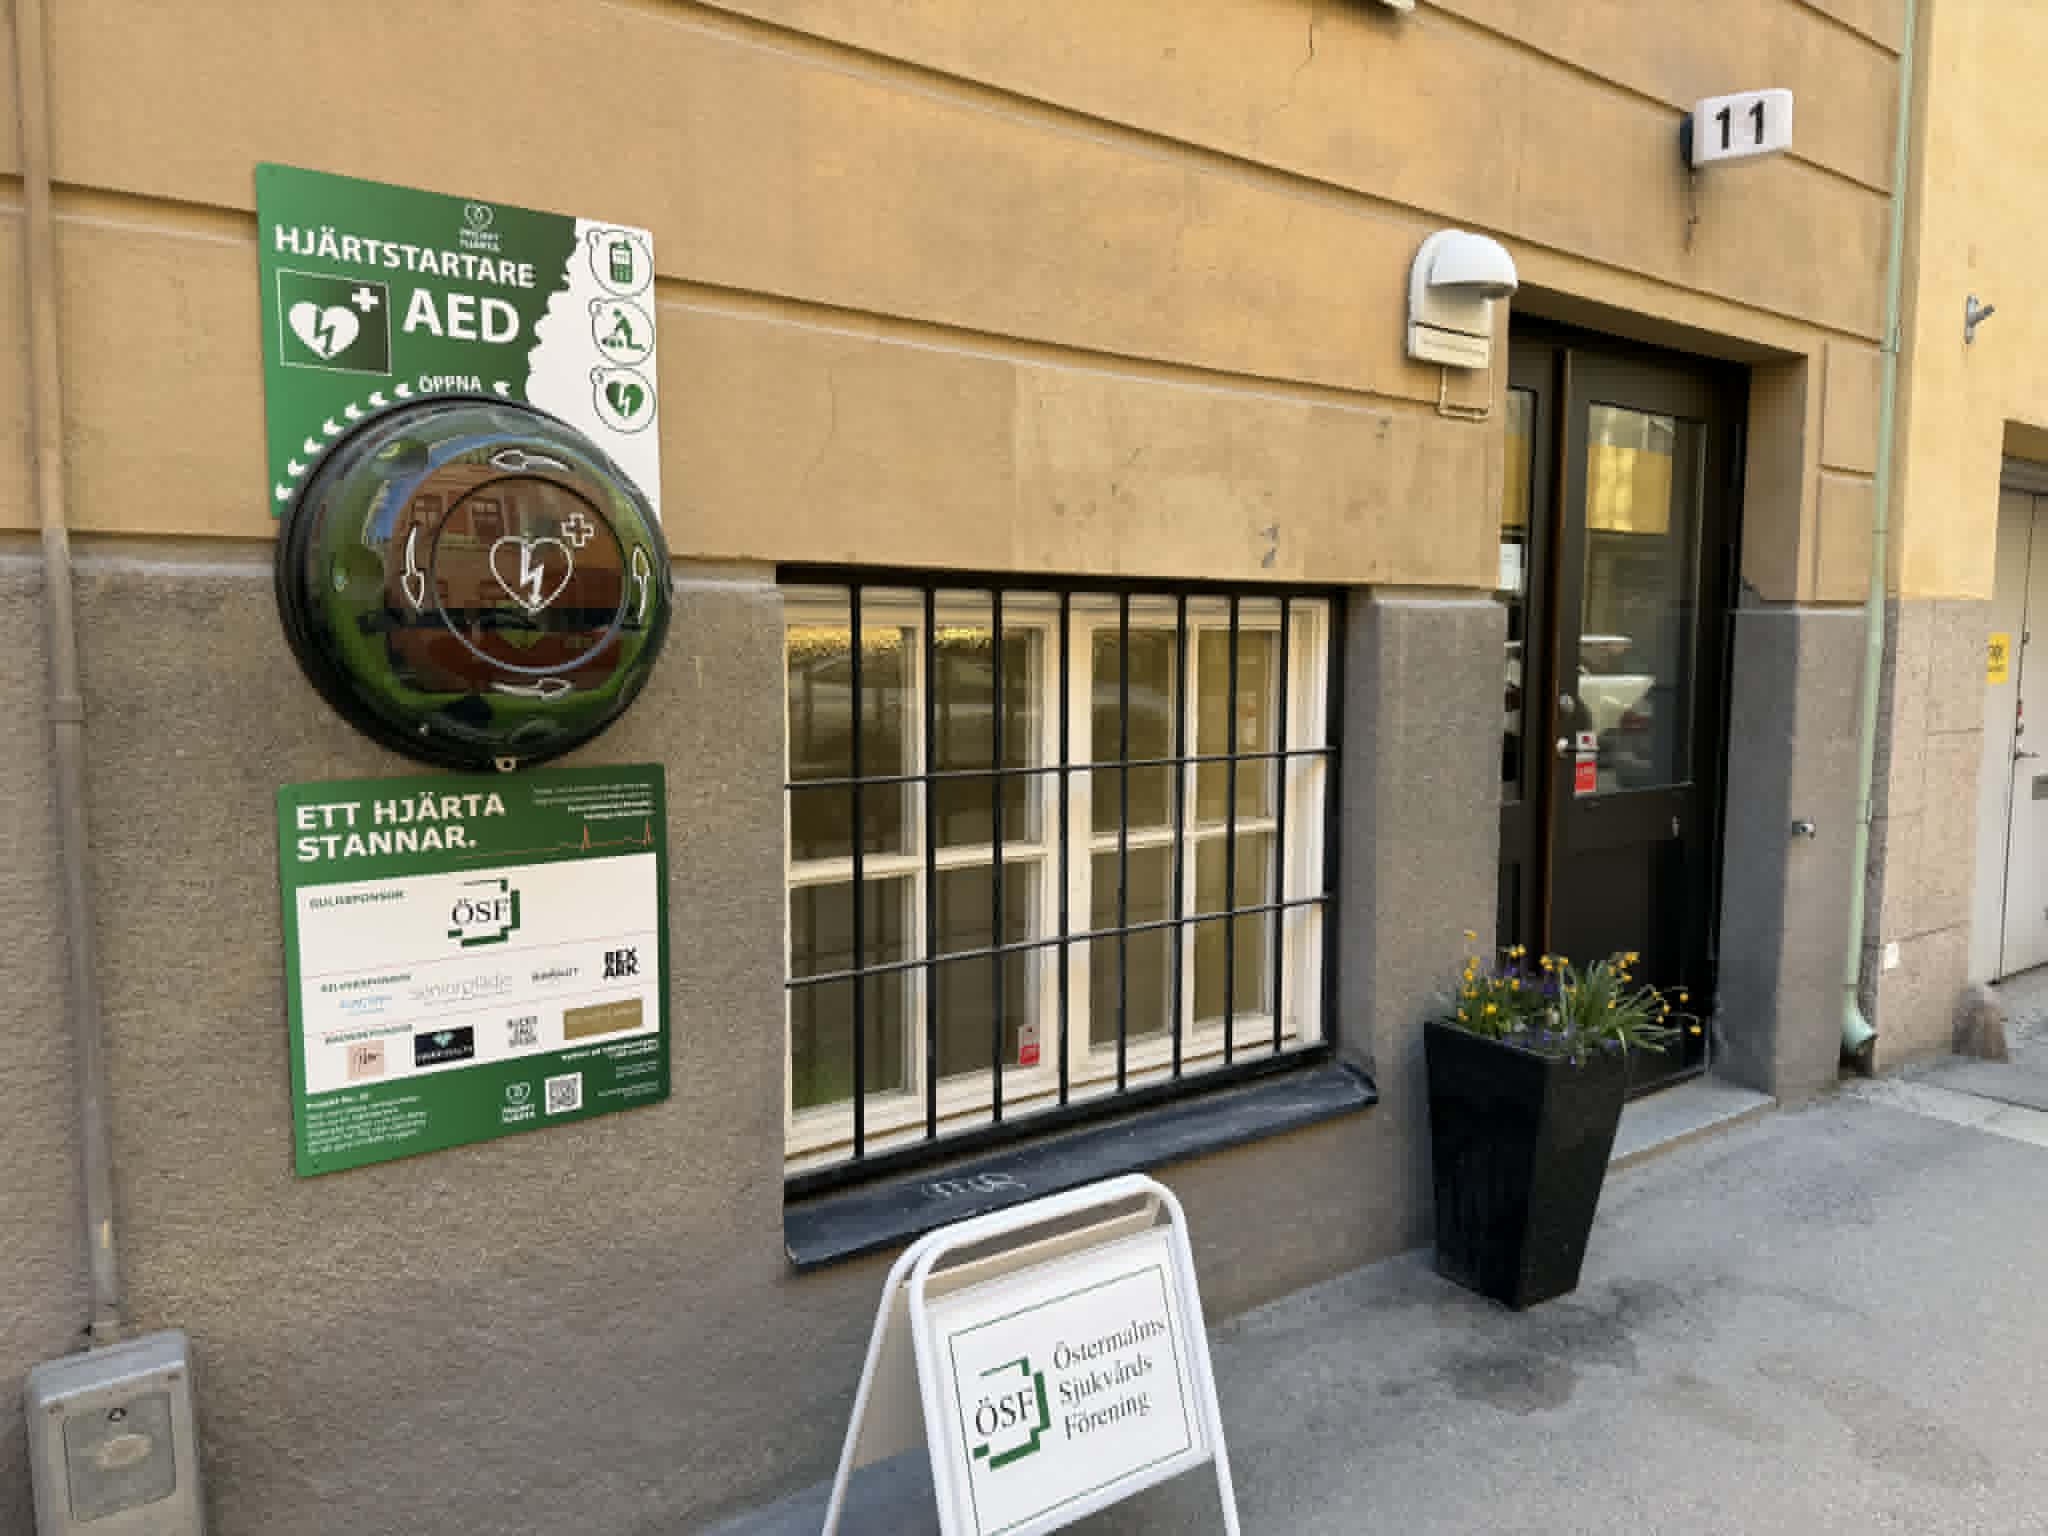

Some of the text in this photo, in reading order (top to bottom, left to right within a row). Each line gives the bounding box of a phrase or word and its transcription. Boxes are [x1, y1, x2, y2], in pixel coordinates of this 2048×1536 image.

[1716, 99, 1764, 151] 11
[274, 223, 536, 289] HJÄRTSTARTARE
[402, 288, 519, 343] AED
[418, 374, 481, 393] ÖPPNA
[296, 802, 360, 830] ETT
[373, 791, 506, 824] HJÄRTA
[296, 825, 478, 862] STANNAR.
[451, 897, 513, 926] ÖSF
[1052, 1317, 1166, 1371] Östermalms
[1058, 1352, 1153, 1408] Sjukvårds
[974, 1387, 1035, 1438] ÖSF
[1064, 1391, 1152, 1441] Förening
